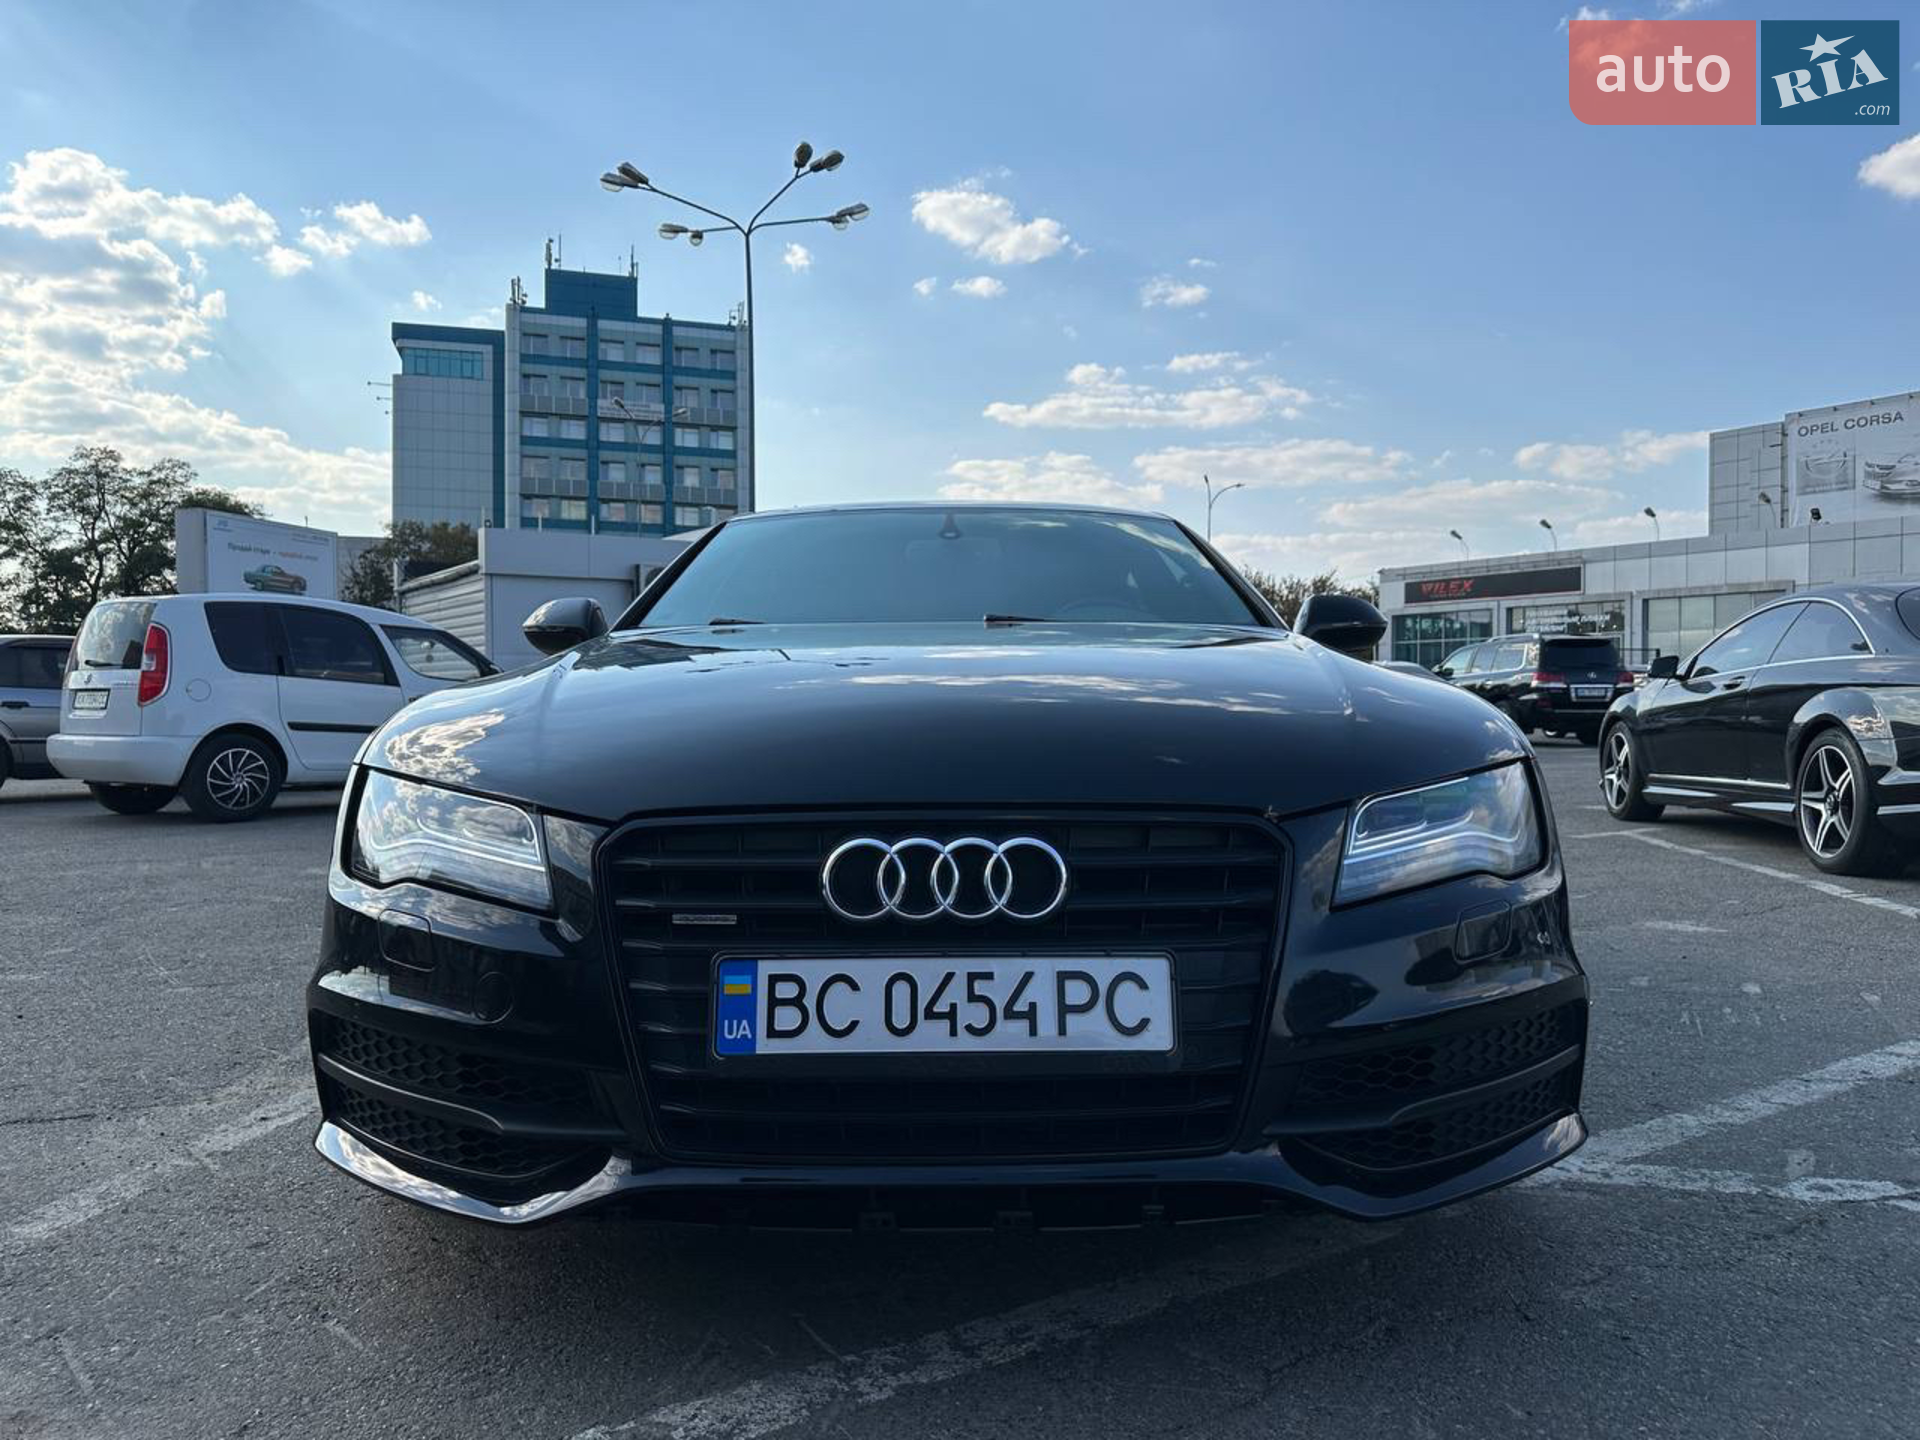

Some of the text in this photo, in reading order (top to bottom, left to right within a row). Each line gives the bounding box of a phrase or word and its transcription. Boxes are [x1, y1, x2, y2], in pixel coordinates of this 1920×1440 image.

[1797, 411, 1905, 438] OPEL CORSA
[765, 970, 1151, 1039] BC 0454 PC
[724, 1019, 752, 1039] UA
